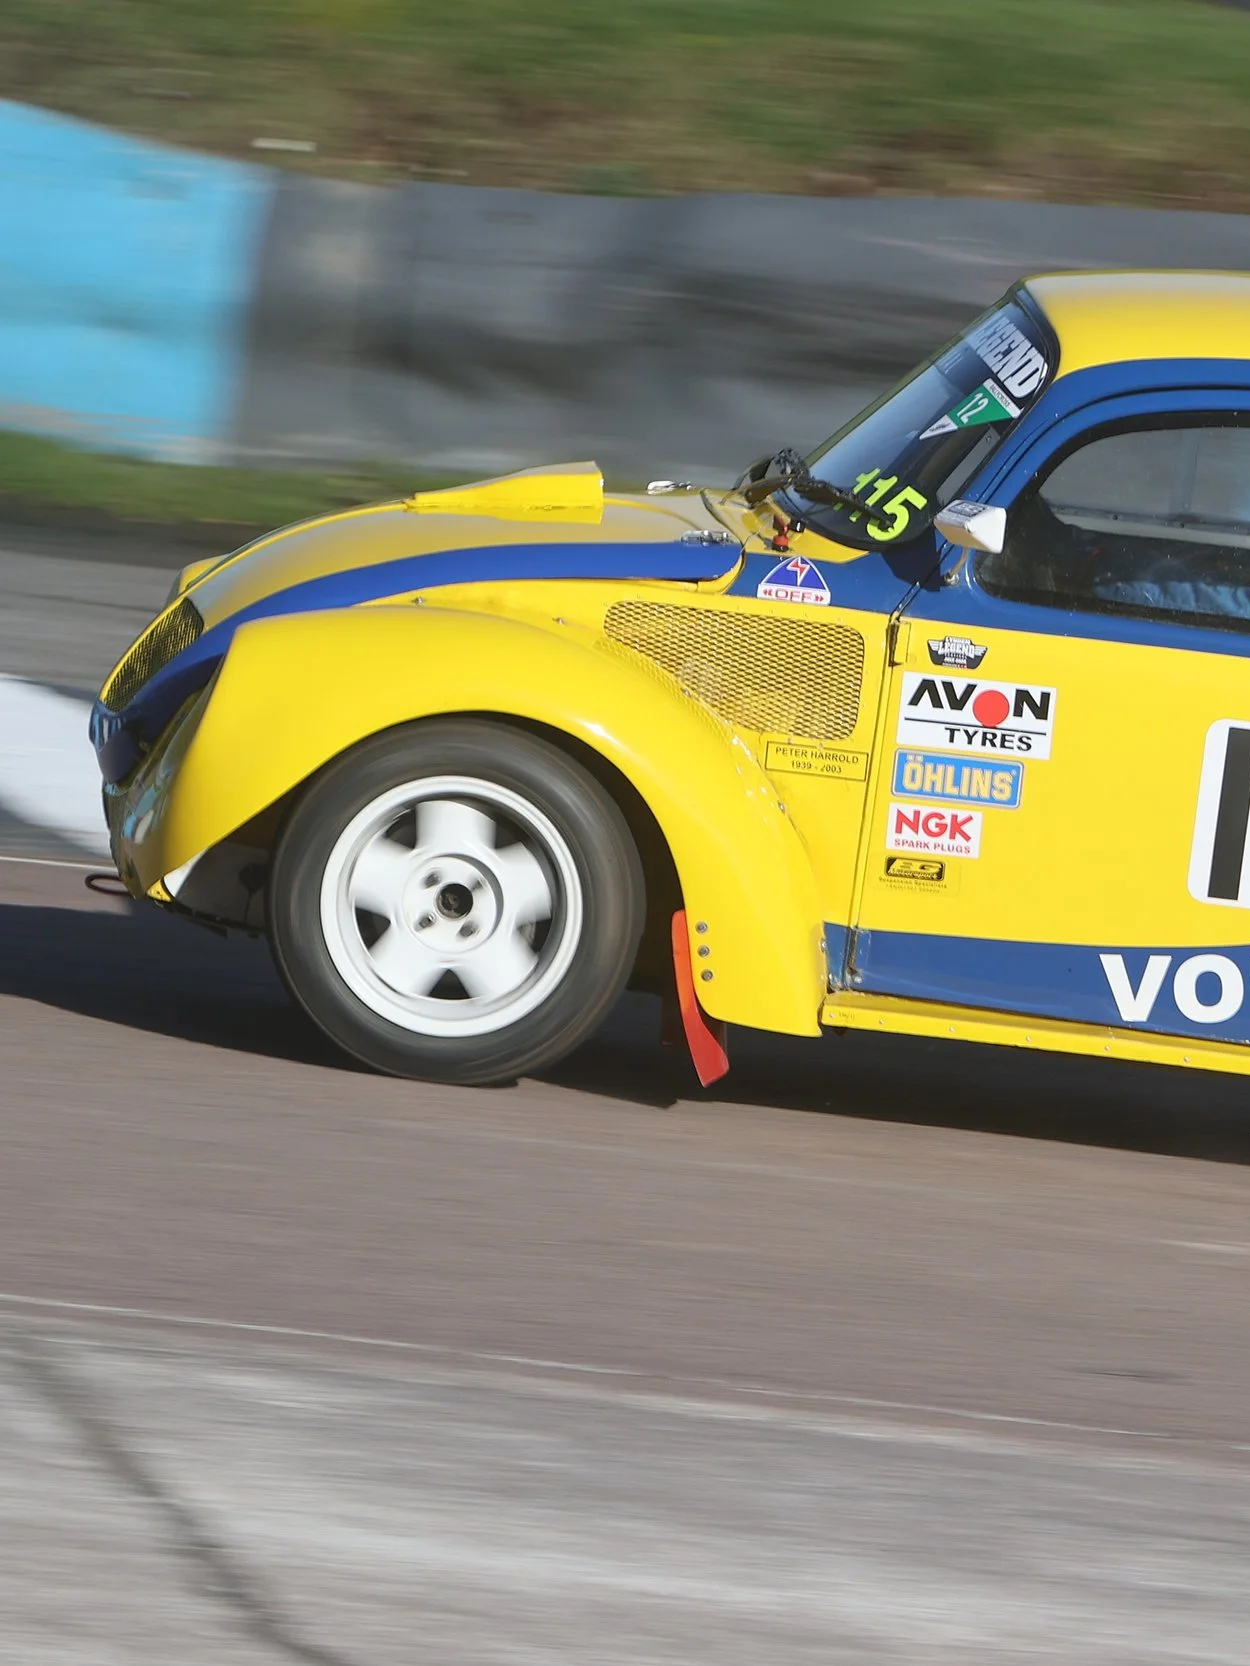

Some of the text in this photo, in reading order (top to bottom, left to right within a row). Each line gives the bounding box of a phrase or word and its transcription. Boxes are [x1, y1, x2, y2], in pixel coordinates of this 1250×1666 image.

[957, 393, 989, 424] 12
[833, 467, 928, 541] 115
[775, 588, 813, 603] OFF
[907, 678, 1050, 728] AVON
[944, 726, 1032, 751] TYRES
[775, 746, 859, 764] PETER HARROLD
[791, 760, 812, 770] 1939
[820, 765, 842, 774] 2003
[902, 754, 1013, 801] ÖHLINS
[895, 808, 973, 843] NGK
[894, 838, 971, 855] SPARK PLUGS
